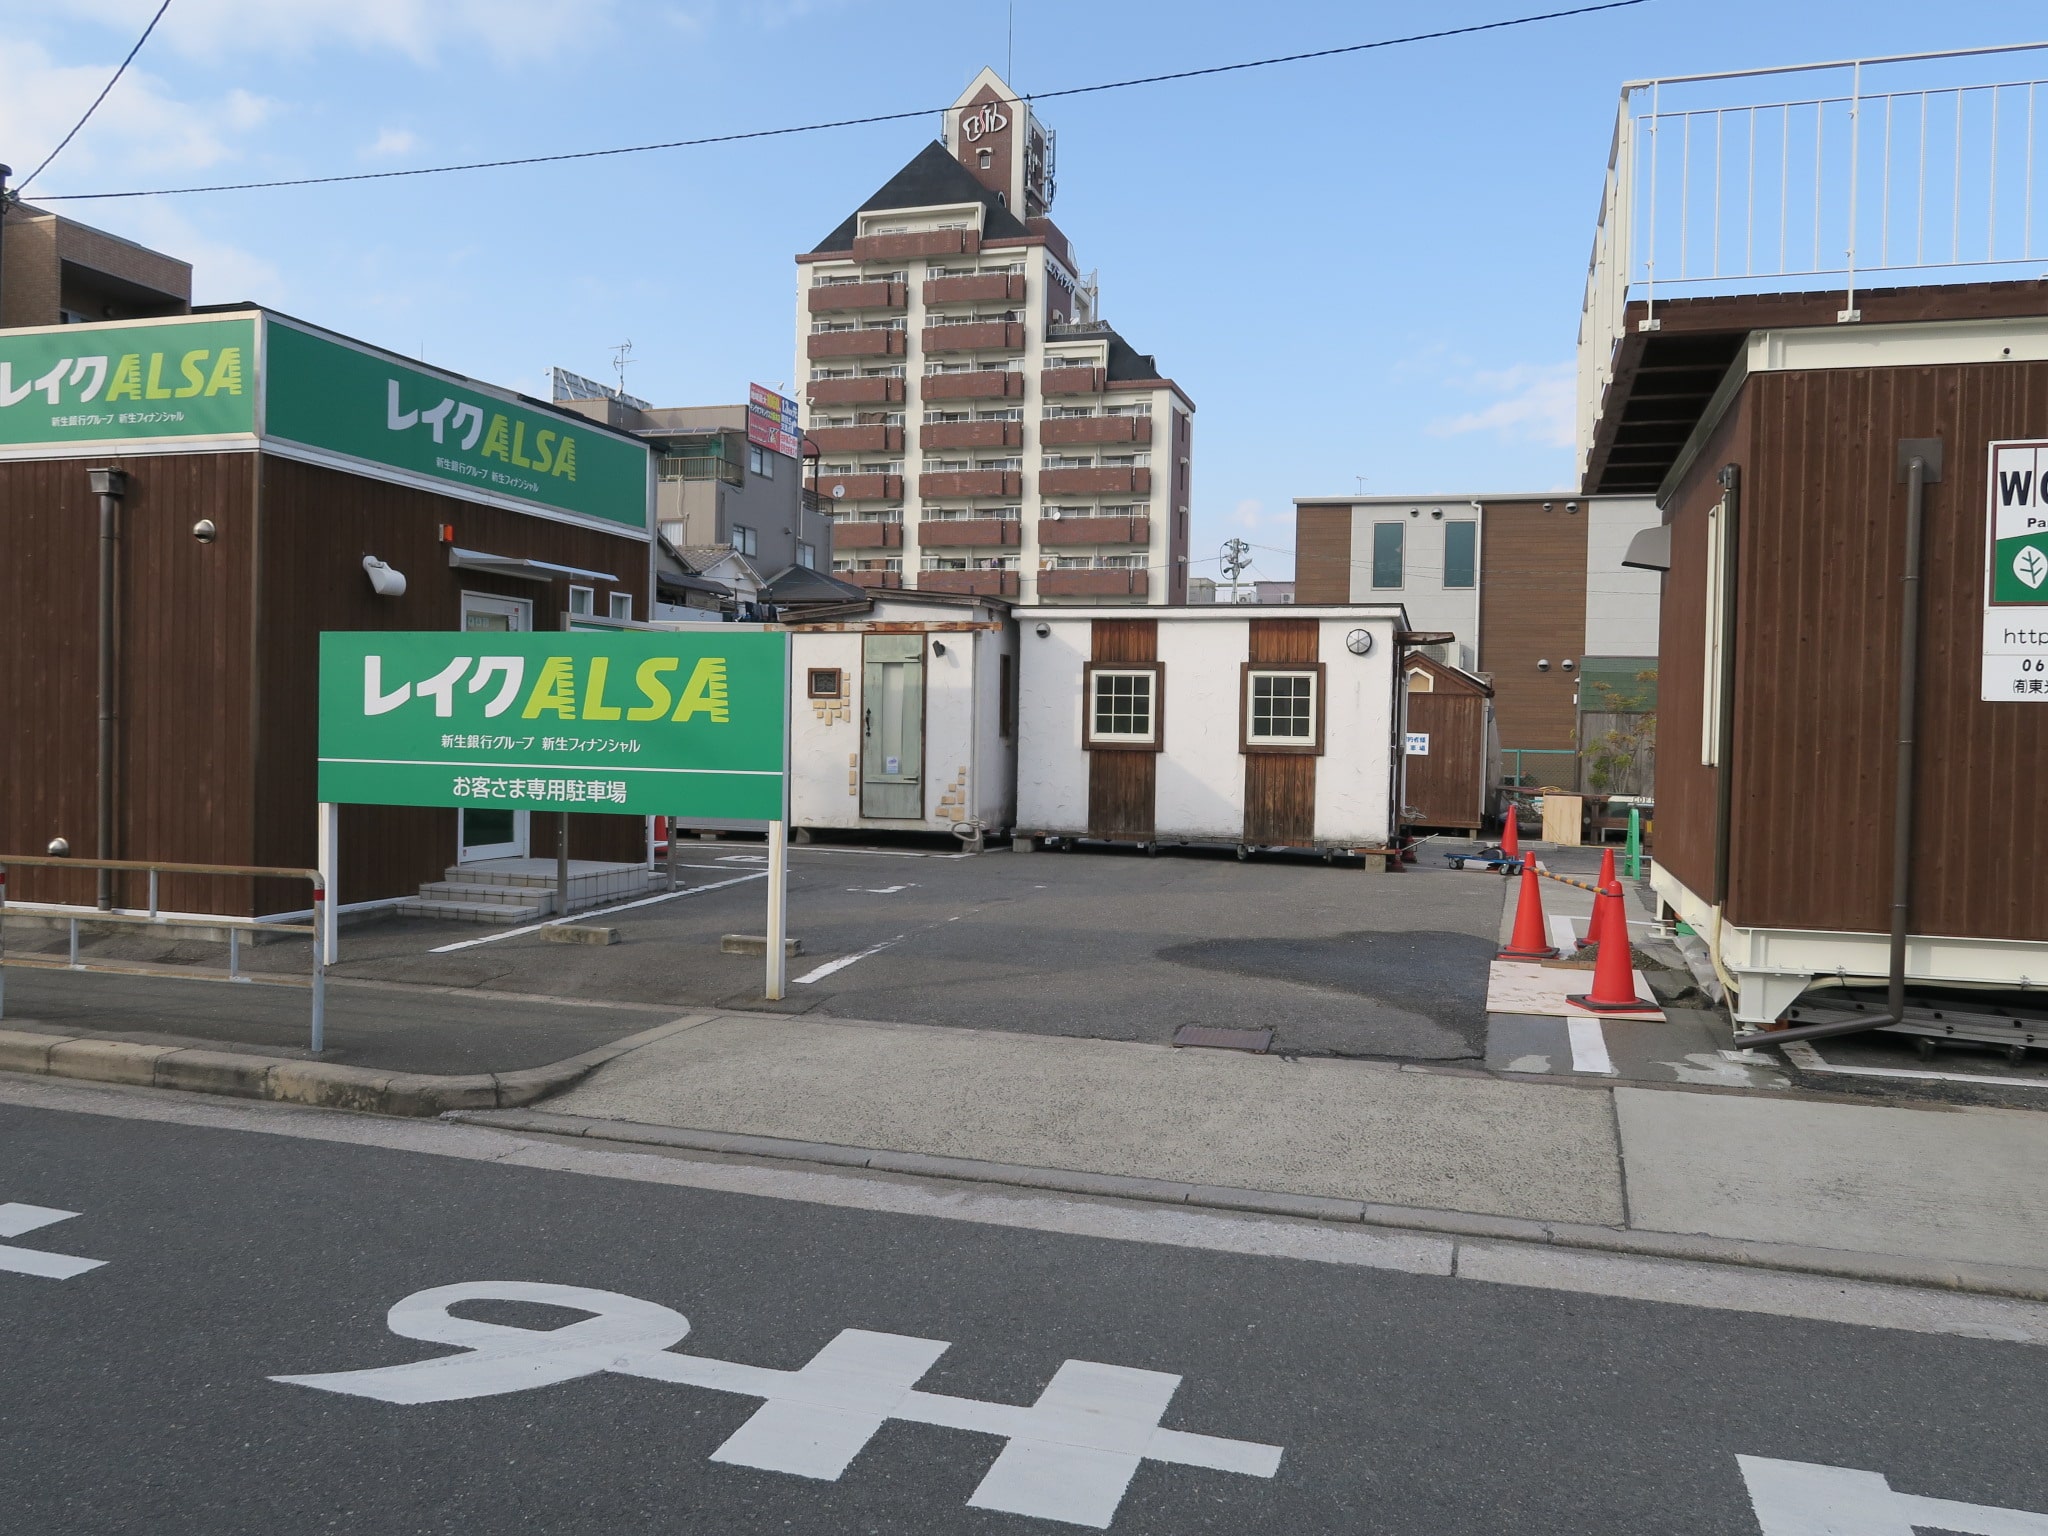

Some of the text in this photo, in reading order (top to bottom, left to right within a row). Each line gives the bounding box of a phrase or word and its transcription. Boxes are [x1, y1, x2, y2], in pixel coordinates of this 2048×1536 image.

[51, 411, 185, 427] 新生銀行グループ 新生フィナンシャル
[387, 379, 576, 481] レイクALSA
[436, 457, 539, 492] 新生銀行グループ 新生フィナンシャル
[1999, 471, 2048, 506] W
[2027, 517, 2048, 528] Pa
[363, 655, 730, 724] レイクALSA
[441, 734, 641, 754] 新生銀行グループ 新生フィナンシャル
[452, 776, 628, 804] お客さま専用駐車場
